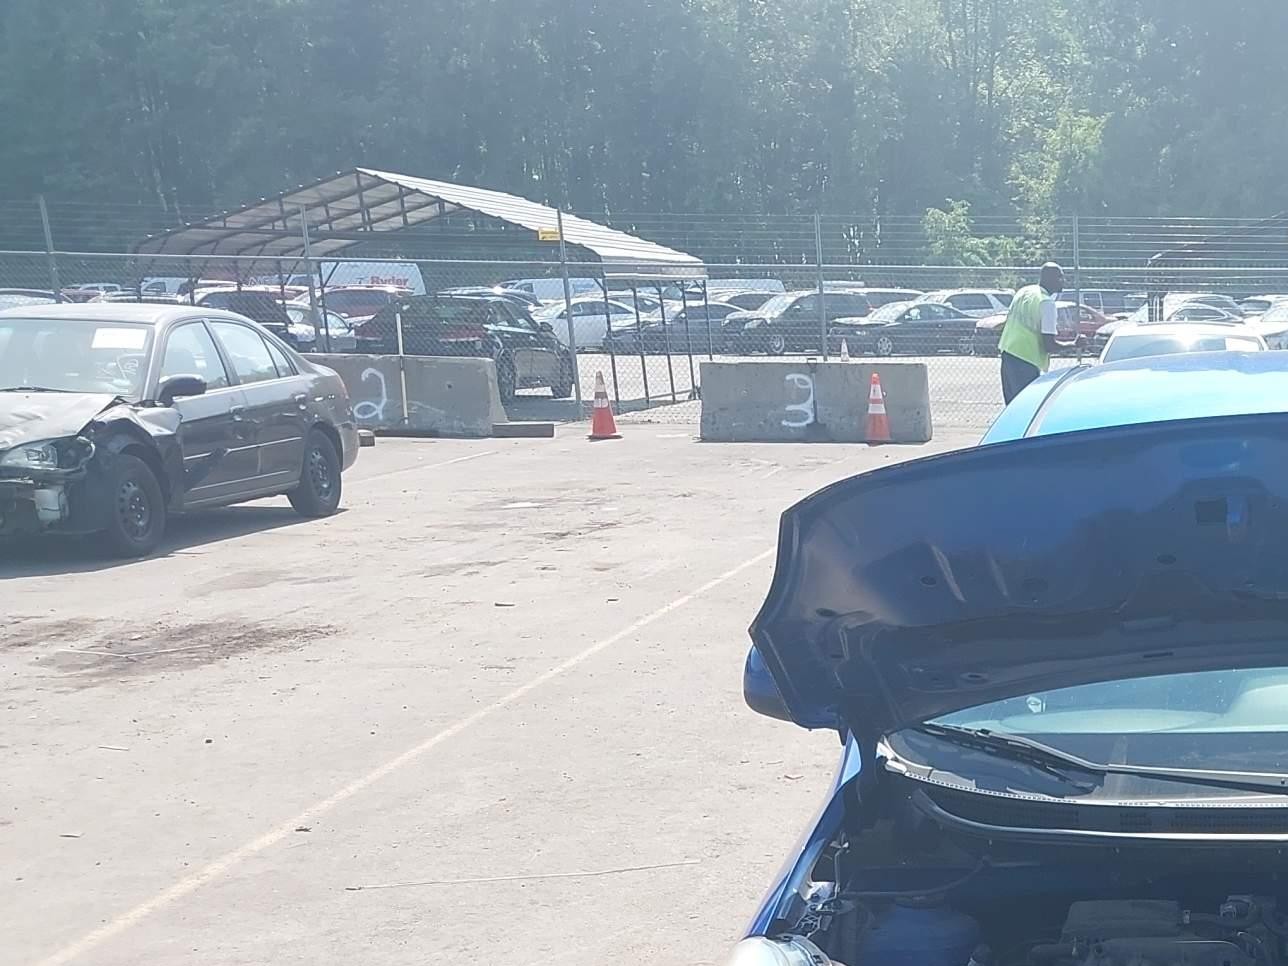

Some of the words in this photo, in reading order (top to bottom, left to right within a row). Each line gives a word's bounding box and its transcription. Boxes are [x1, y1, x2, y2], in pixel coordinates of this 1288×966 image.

[370, 275, 410, 286] Ryder
[353, 368, 388, 420] 2
[782, 374, 815, 427] 3
